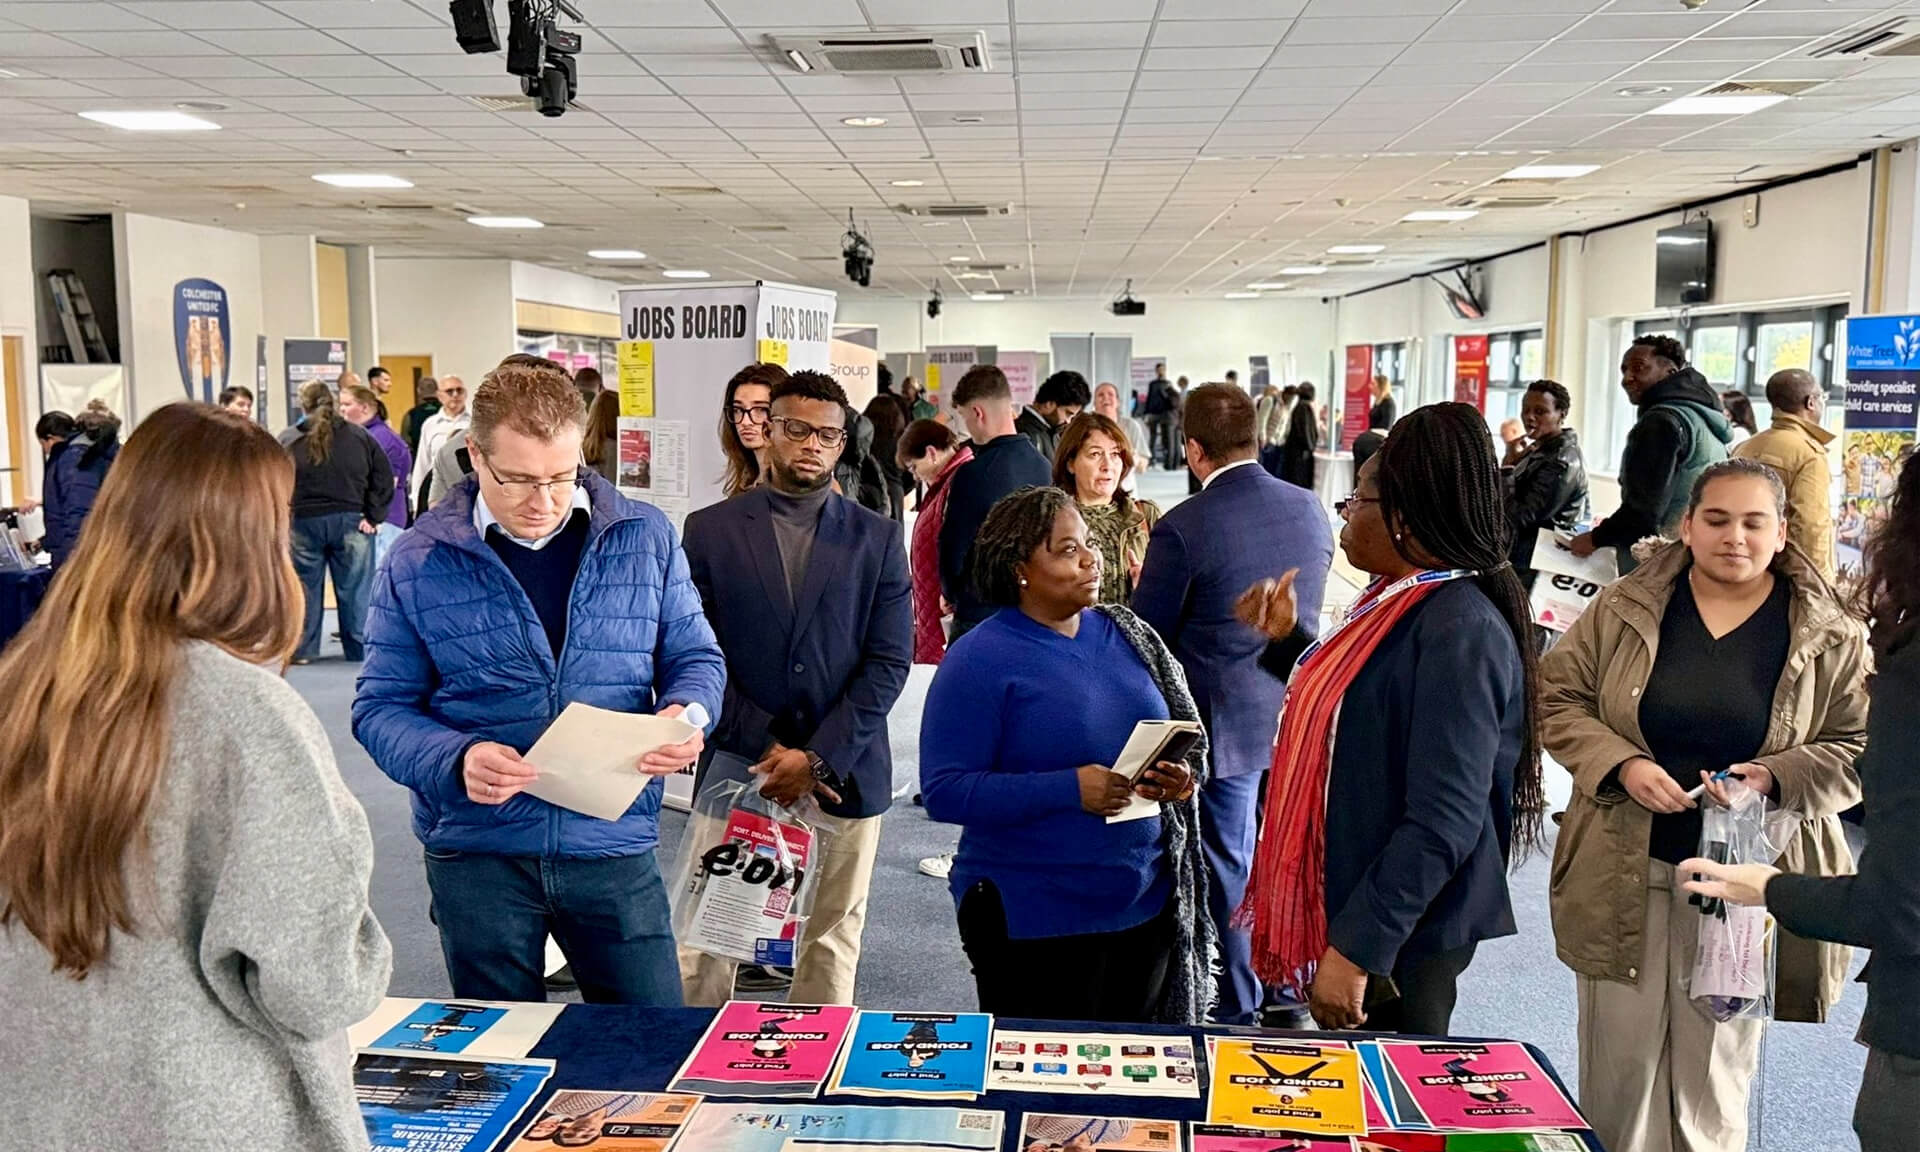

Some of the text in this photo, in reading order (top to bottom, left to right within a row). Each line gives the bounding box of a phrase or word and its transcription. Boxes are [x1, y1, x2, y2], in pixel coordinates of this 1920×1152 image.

[182, 288, 223, 301] COLCHESTER
[187, 301, 209, 312] UNITED
[627, 304, 747, 339] JOBS BOARD
[766, 304, 829, 343] JOBS BOARD
[929, 351, 974, 363] JOBS BOARD
[1846, 380, 1916, 396] Providing specialist
[1846, 399, 1913, 413] child care services
[728, 1032, 824, 1040] FOUND A JOB
[871, 1042, 968, 1050] FOUND A JOB
[733, 1061, 754, 1069] job?
[1234, 1076, 1340, 1088] FOUND A JOB
[1424, 1072, 1525, 1085] FOUND A JOB
[1472, 1107, 1493, 1115] job?
[418, 1140, 467, 1150] SKILLS
